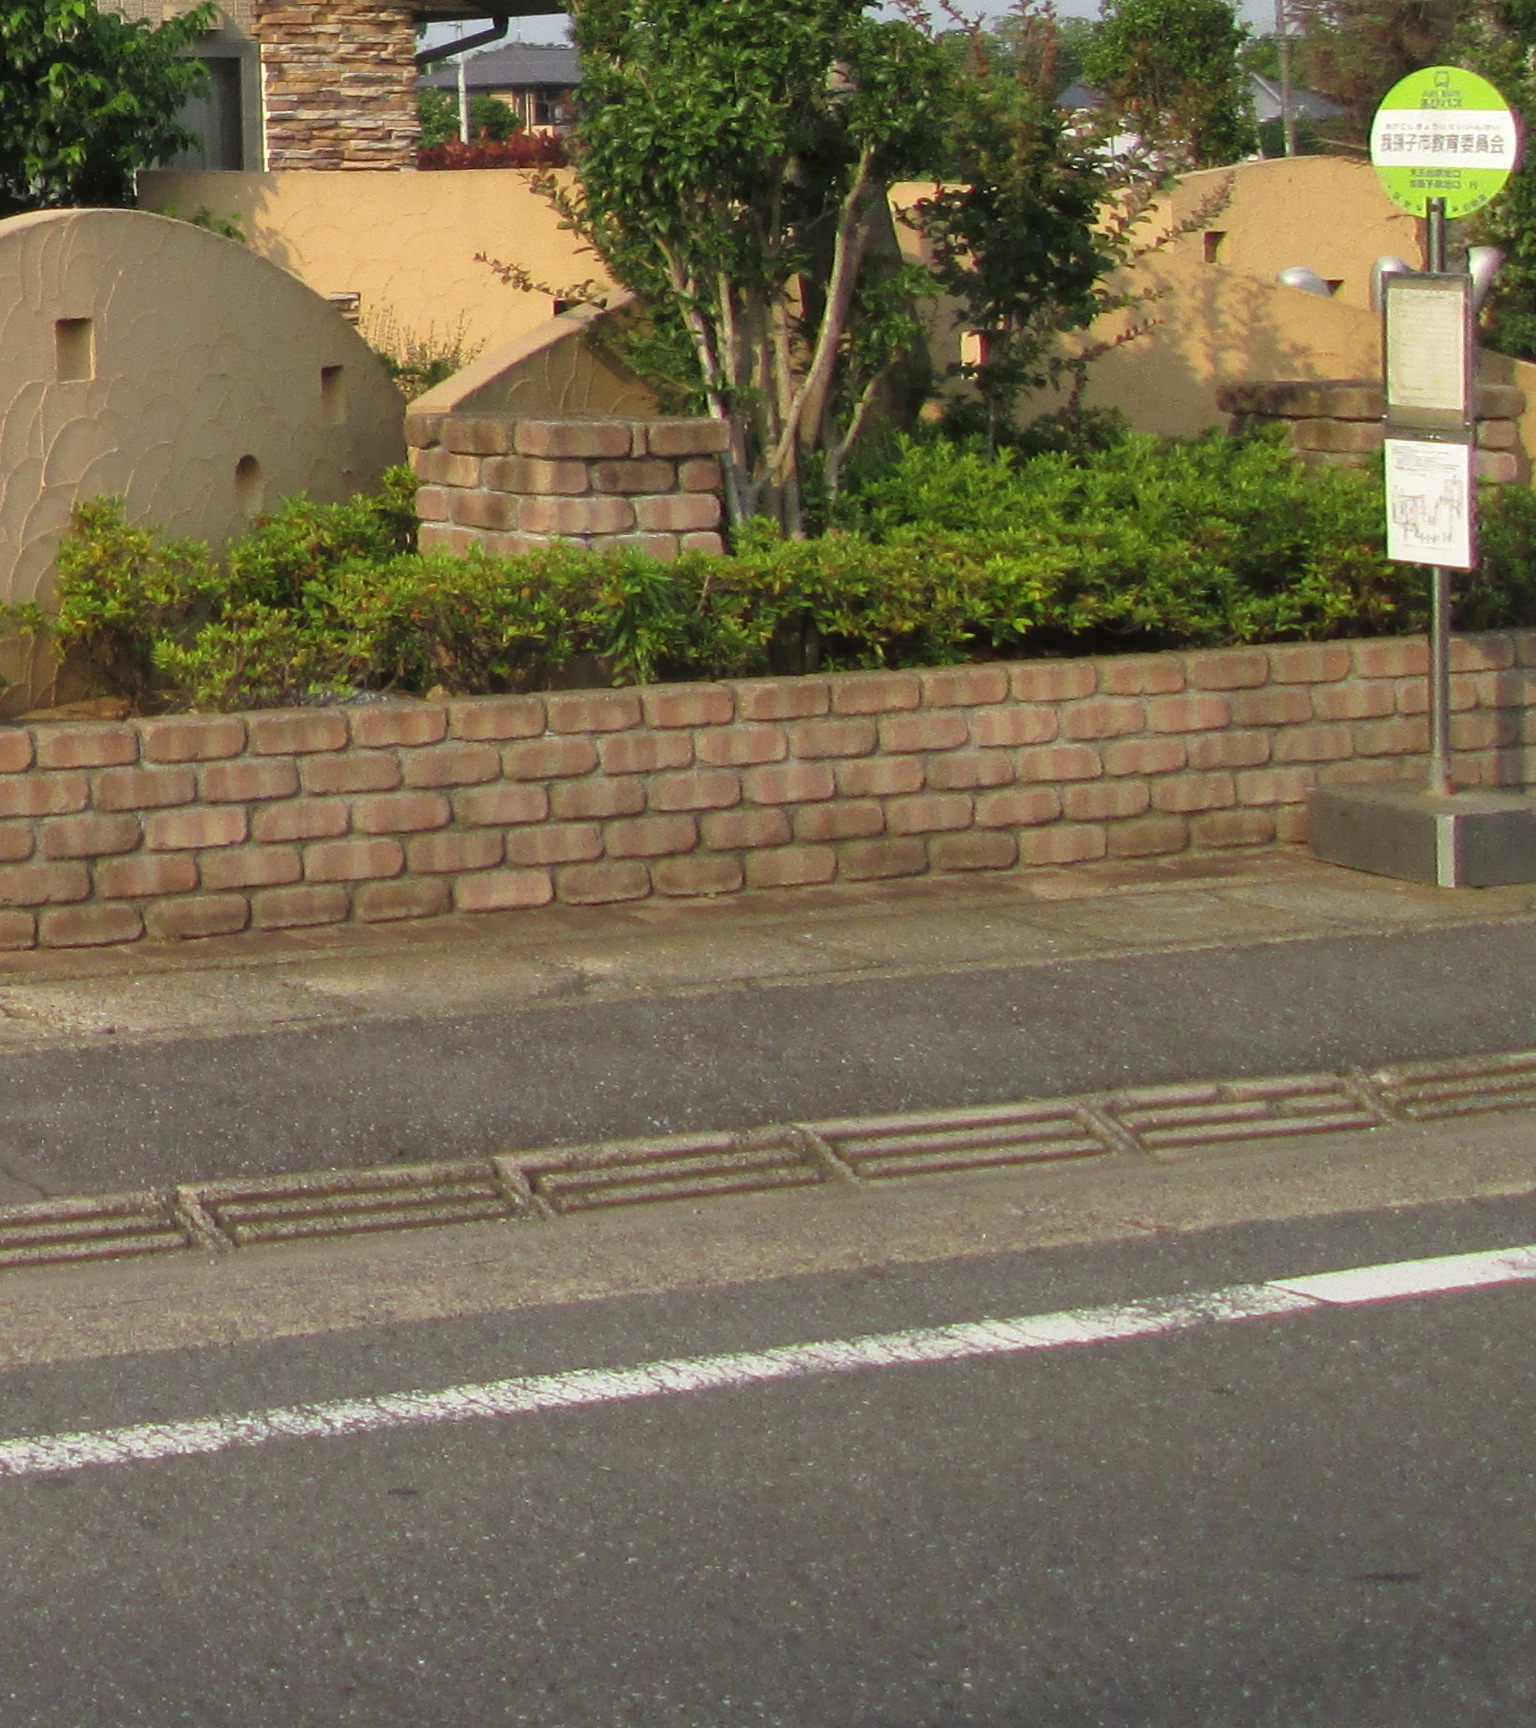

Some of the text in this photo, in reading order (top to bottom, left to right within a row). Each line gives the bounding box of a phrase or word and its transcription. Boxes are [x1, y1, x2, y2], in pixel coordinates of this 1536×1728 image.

[1380, 133, 1505, 153] 我孫子市教育委員会
